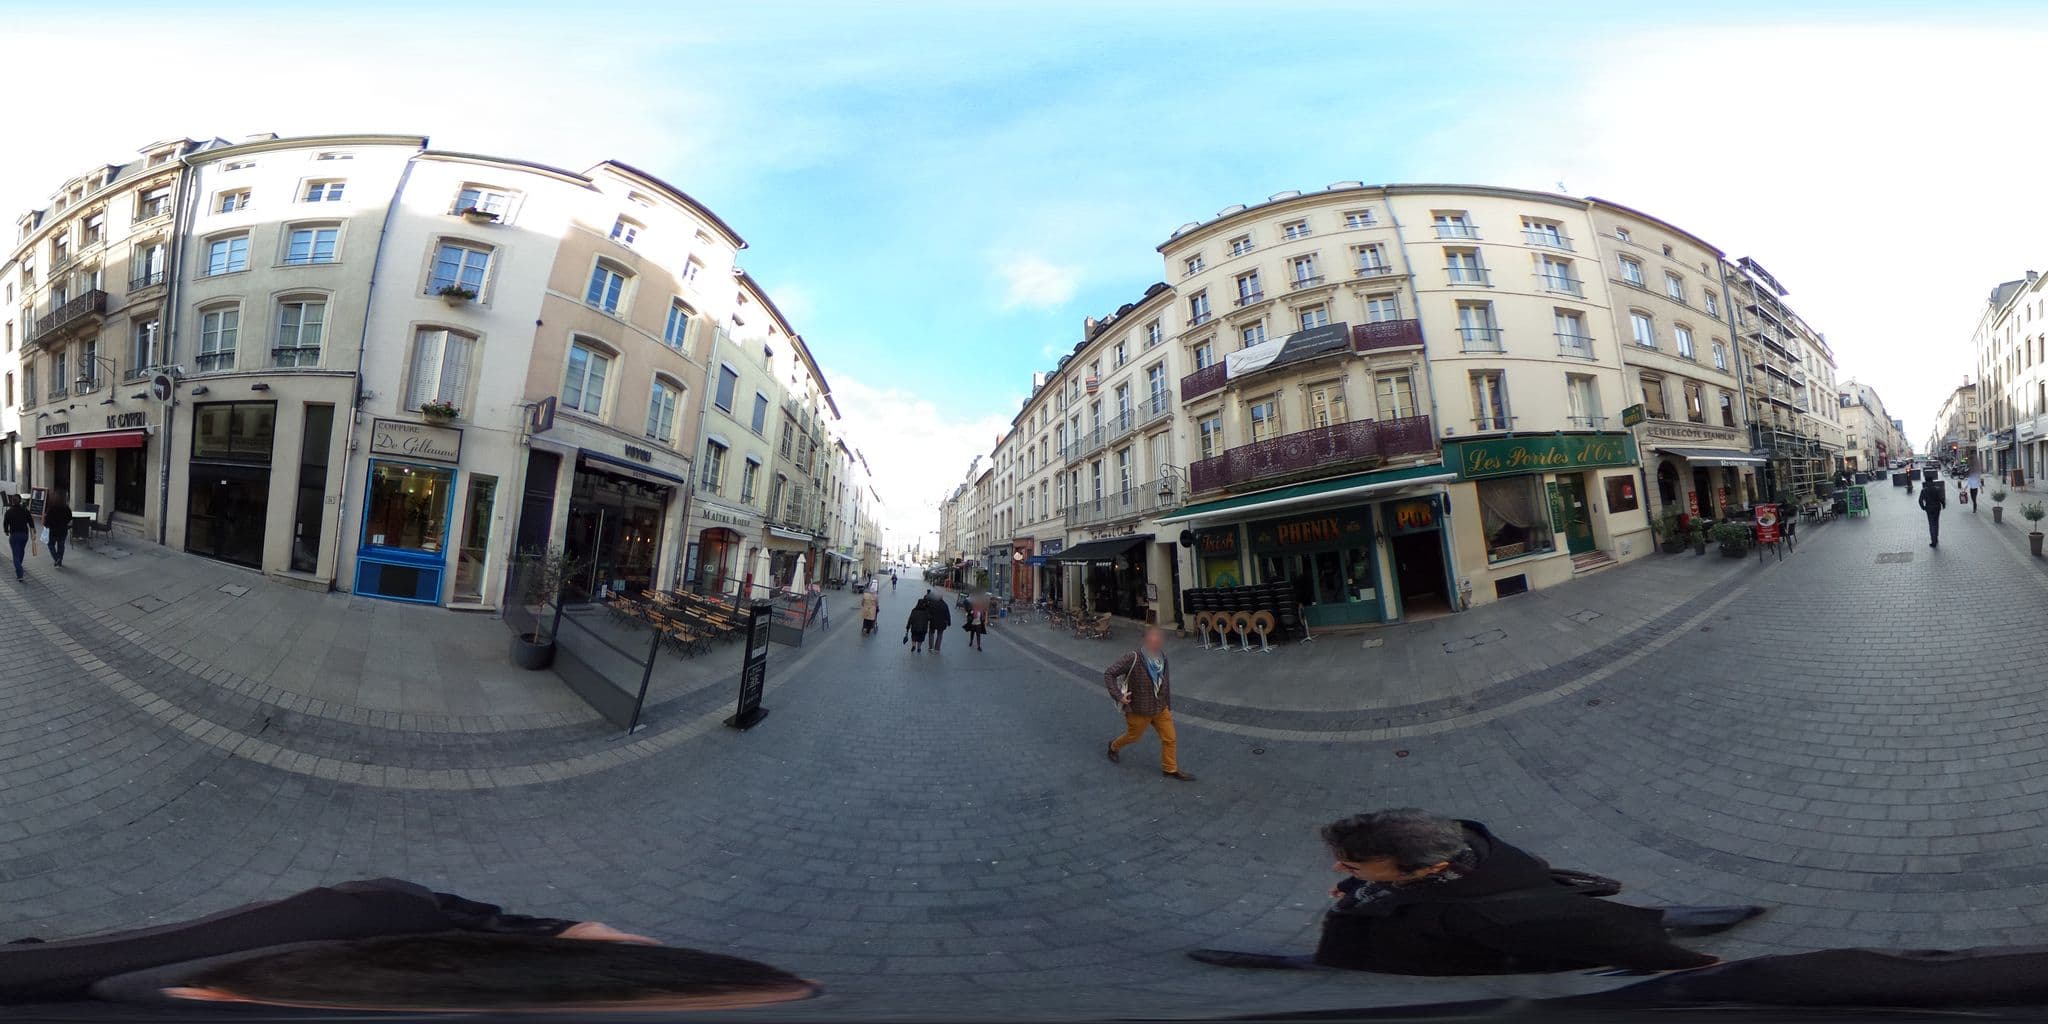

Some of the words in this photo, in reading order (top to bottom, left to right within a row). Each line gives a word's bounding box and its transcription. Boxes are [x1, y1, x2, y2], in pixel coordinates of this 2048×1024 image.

[379, 423, 419, 433] COIFFURE
[1469, 448, 1501, 472] Les
[1397, 503, 1432, 529] PUB
